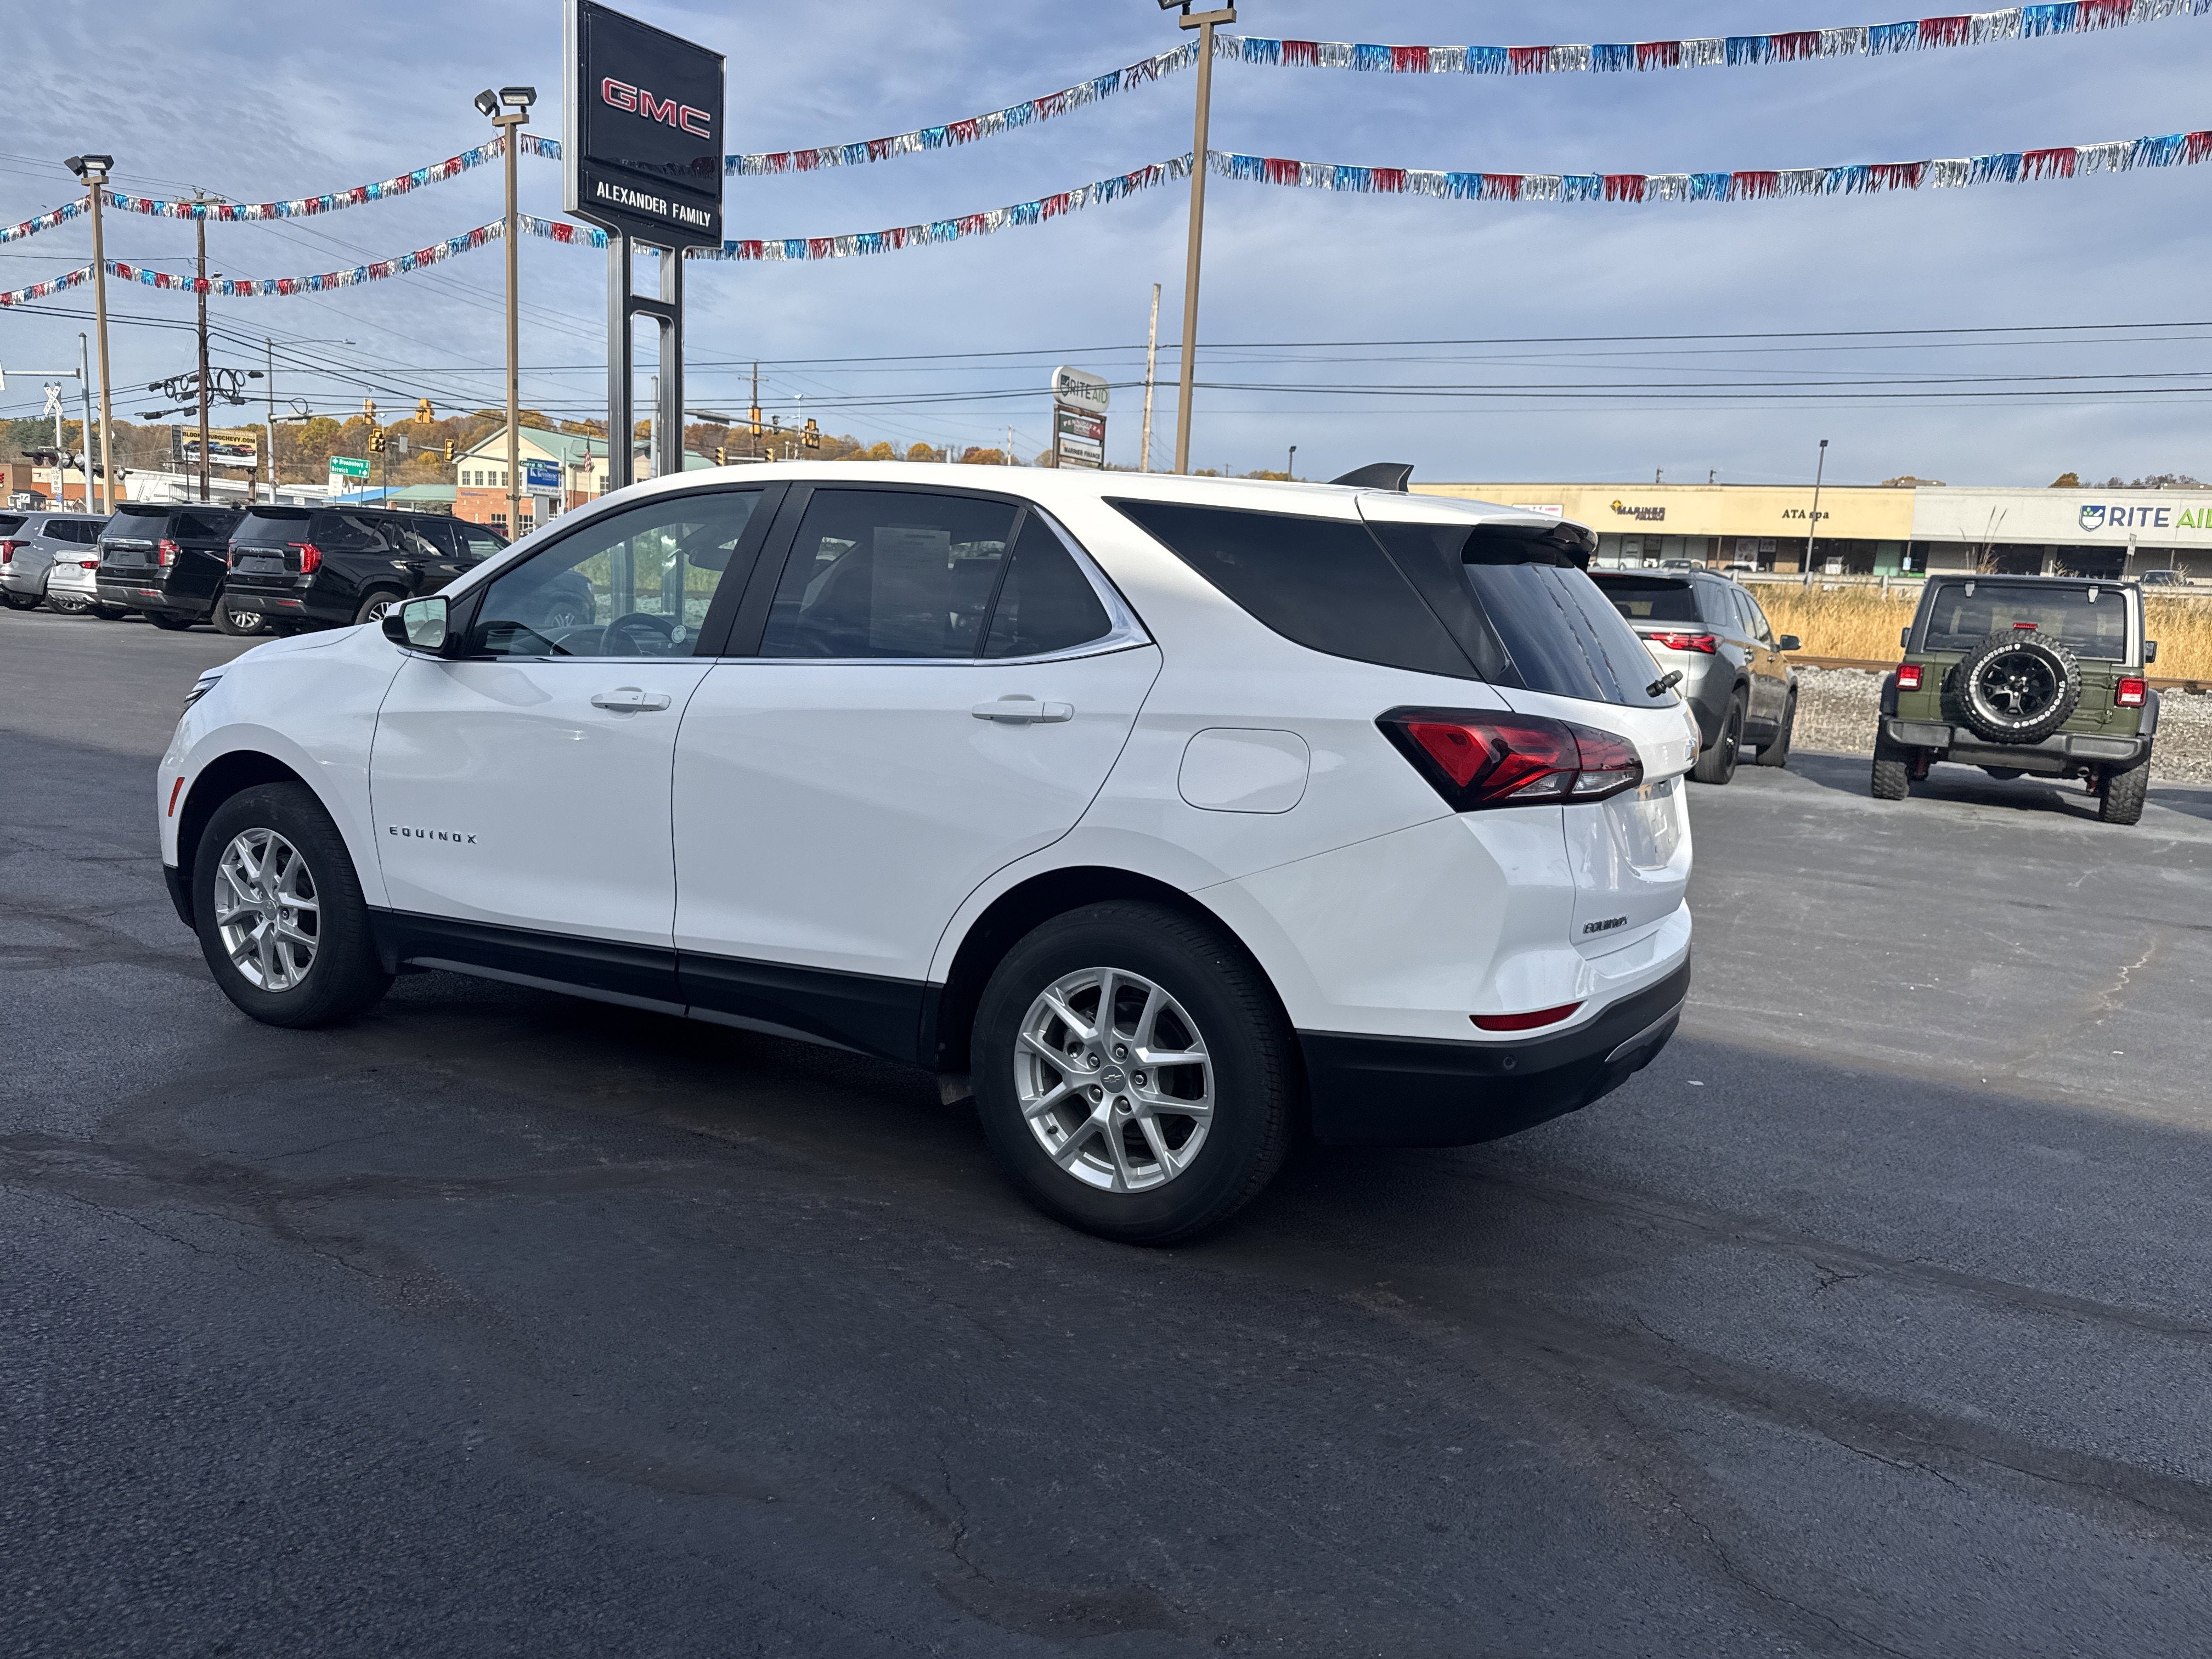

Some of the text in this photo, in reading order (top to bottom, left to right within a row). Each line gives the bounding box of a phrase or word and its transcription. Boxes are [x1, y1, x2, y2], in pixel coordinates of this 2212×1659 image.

[602, 77, 711, 139] GMC
[596, 181, 711, 228] ALEXANDER FAMILY
[1070, 379, 1108, 404] RITE AID
[331, 465, 348, 473] Berwick
[338, 459, 364, 469] Bloomsburg
[1617, 506, 1666, 515] MARINER
[1781, 509, 1830, 522] ATA spa
[2108, 506, 2171, 528] RITE
[389, 825, 478, 844] EQUINOX
